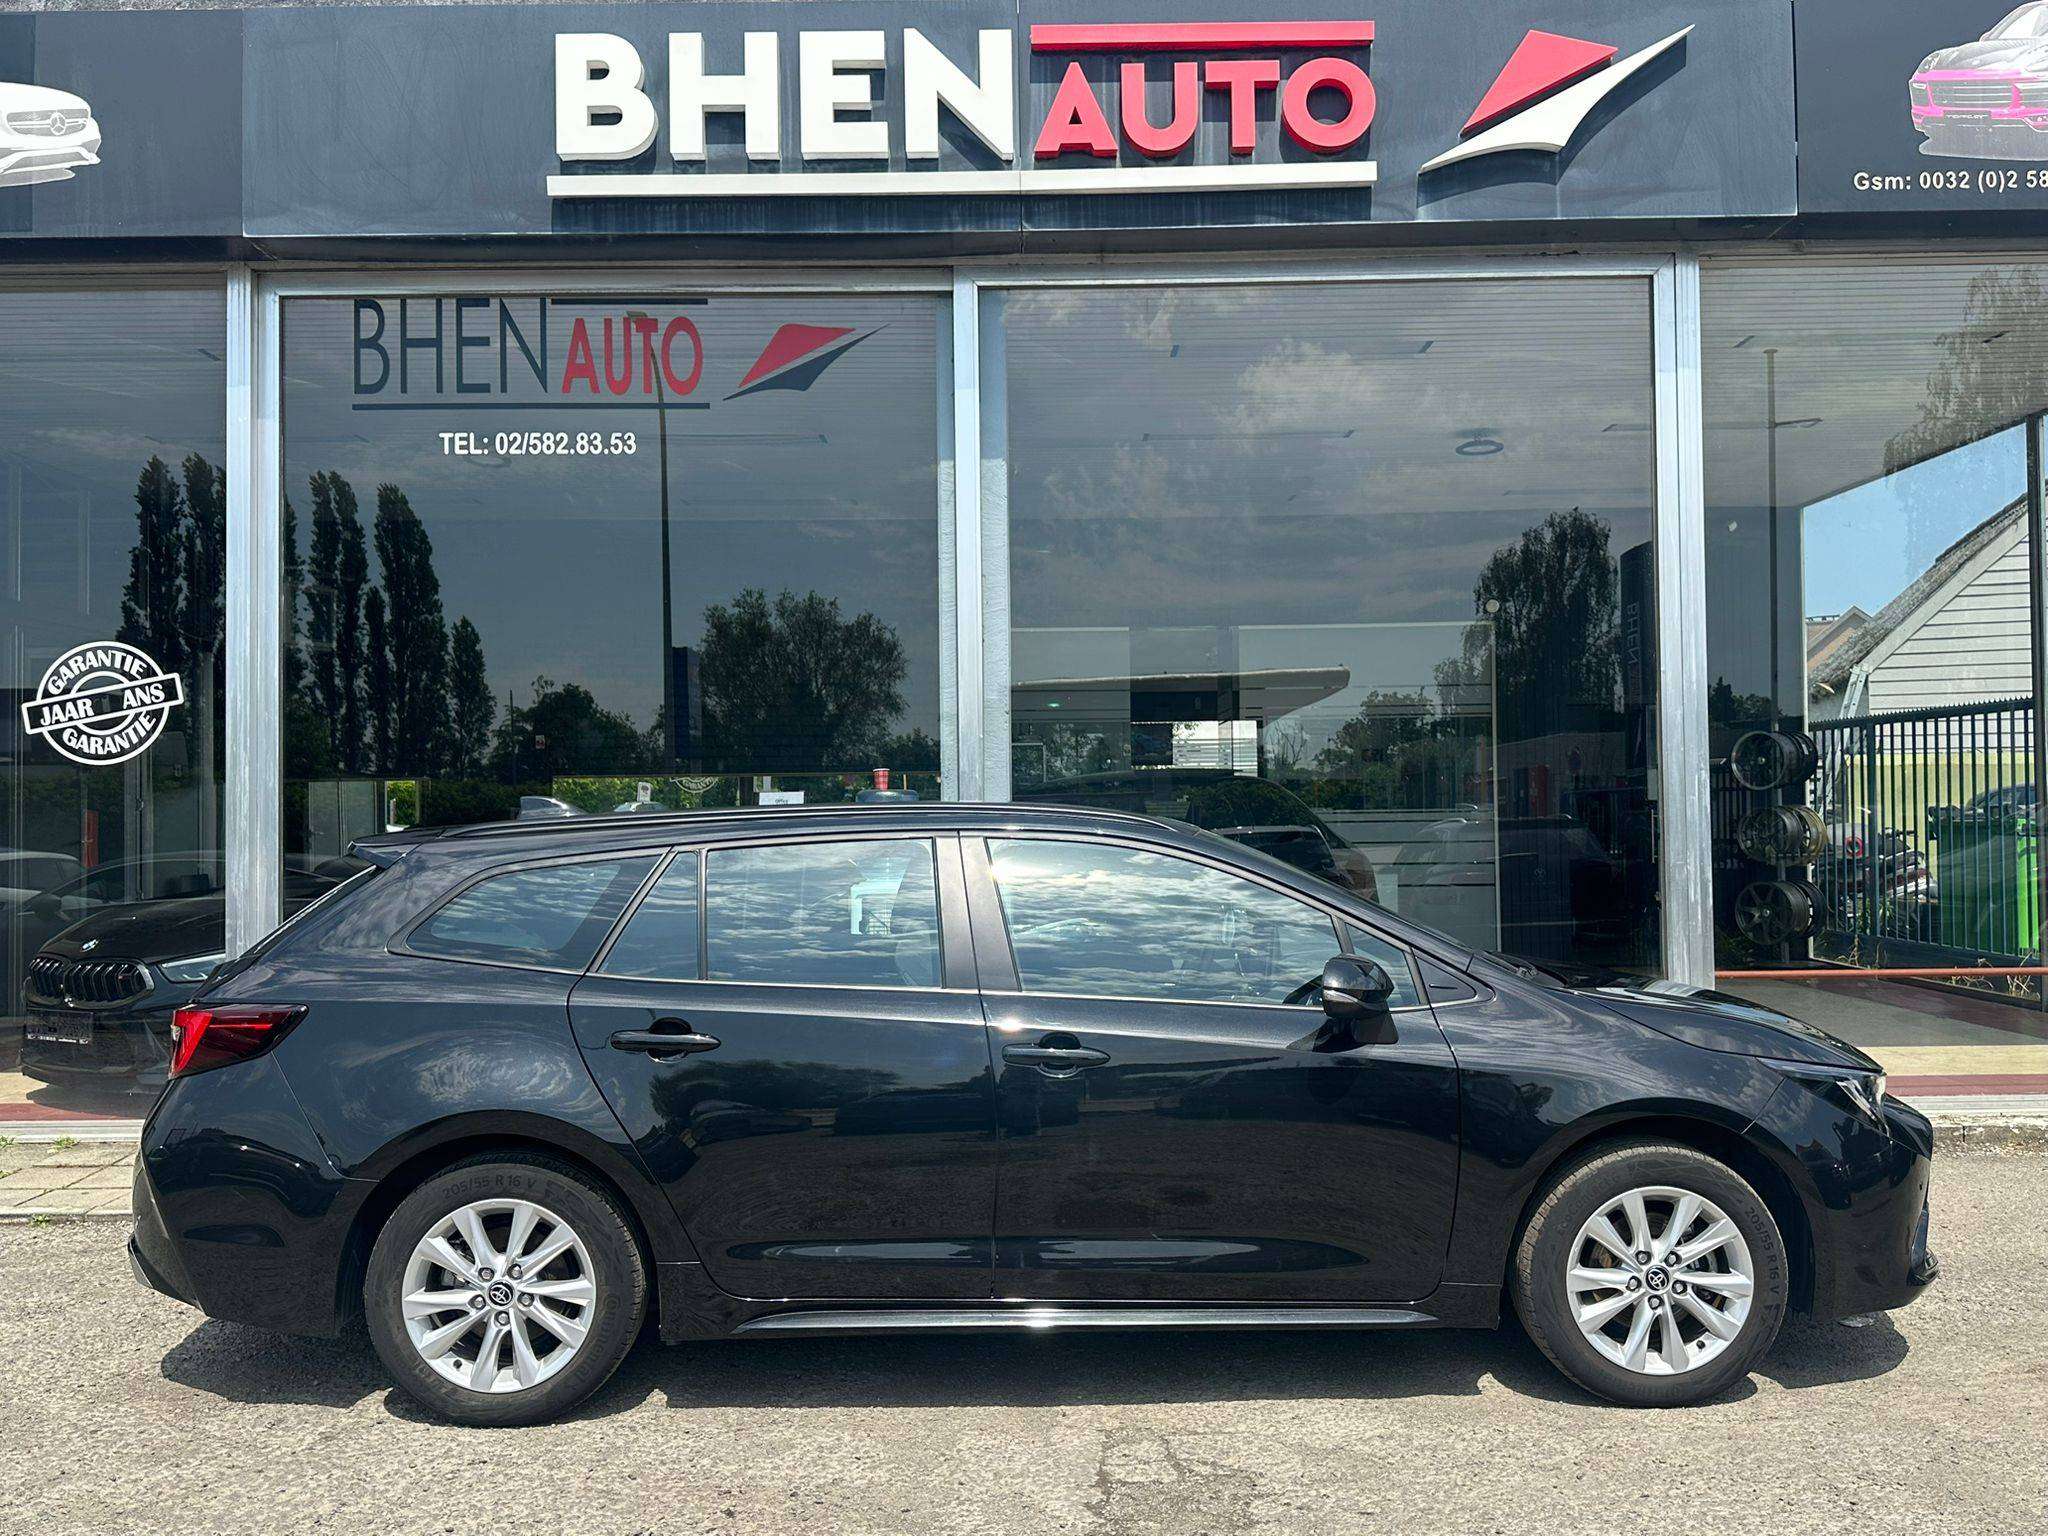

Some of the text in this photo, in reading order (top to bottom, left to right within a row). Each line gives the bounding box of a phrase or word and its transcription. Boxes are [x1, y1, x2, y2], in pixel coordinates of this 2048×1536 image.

[555, 28, 1377, 162] BHEN AUTO
[1853, 171, 1911, 191] Gsm:
[1919, 171, 1970, 190] 0032
[1978, 170, 2018, 194] (0)2
[354, 297, 704, 396] BHEN AUTO
[438, 432, 637, 455] TEL: 02/582.83.53
[47, 649, 148, 695] GARANTIE
[40, 683, 166, 726] JAAR ANS
[62, 711, 157, 755] GARANTIE
